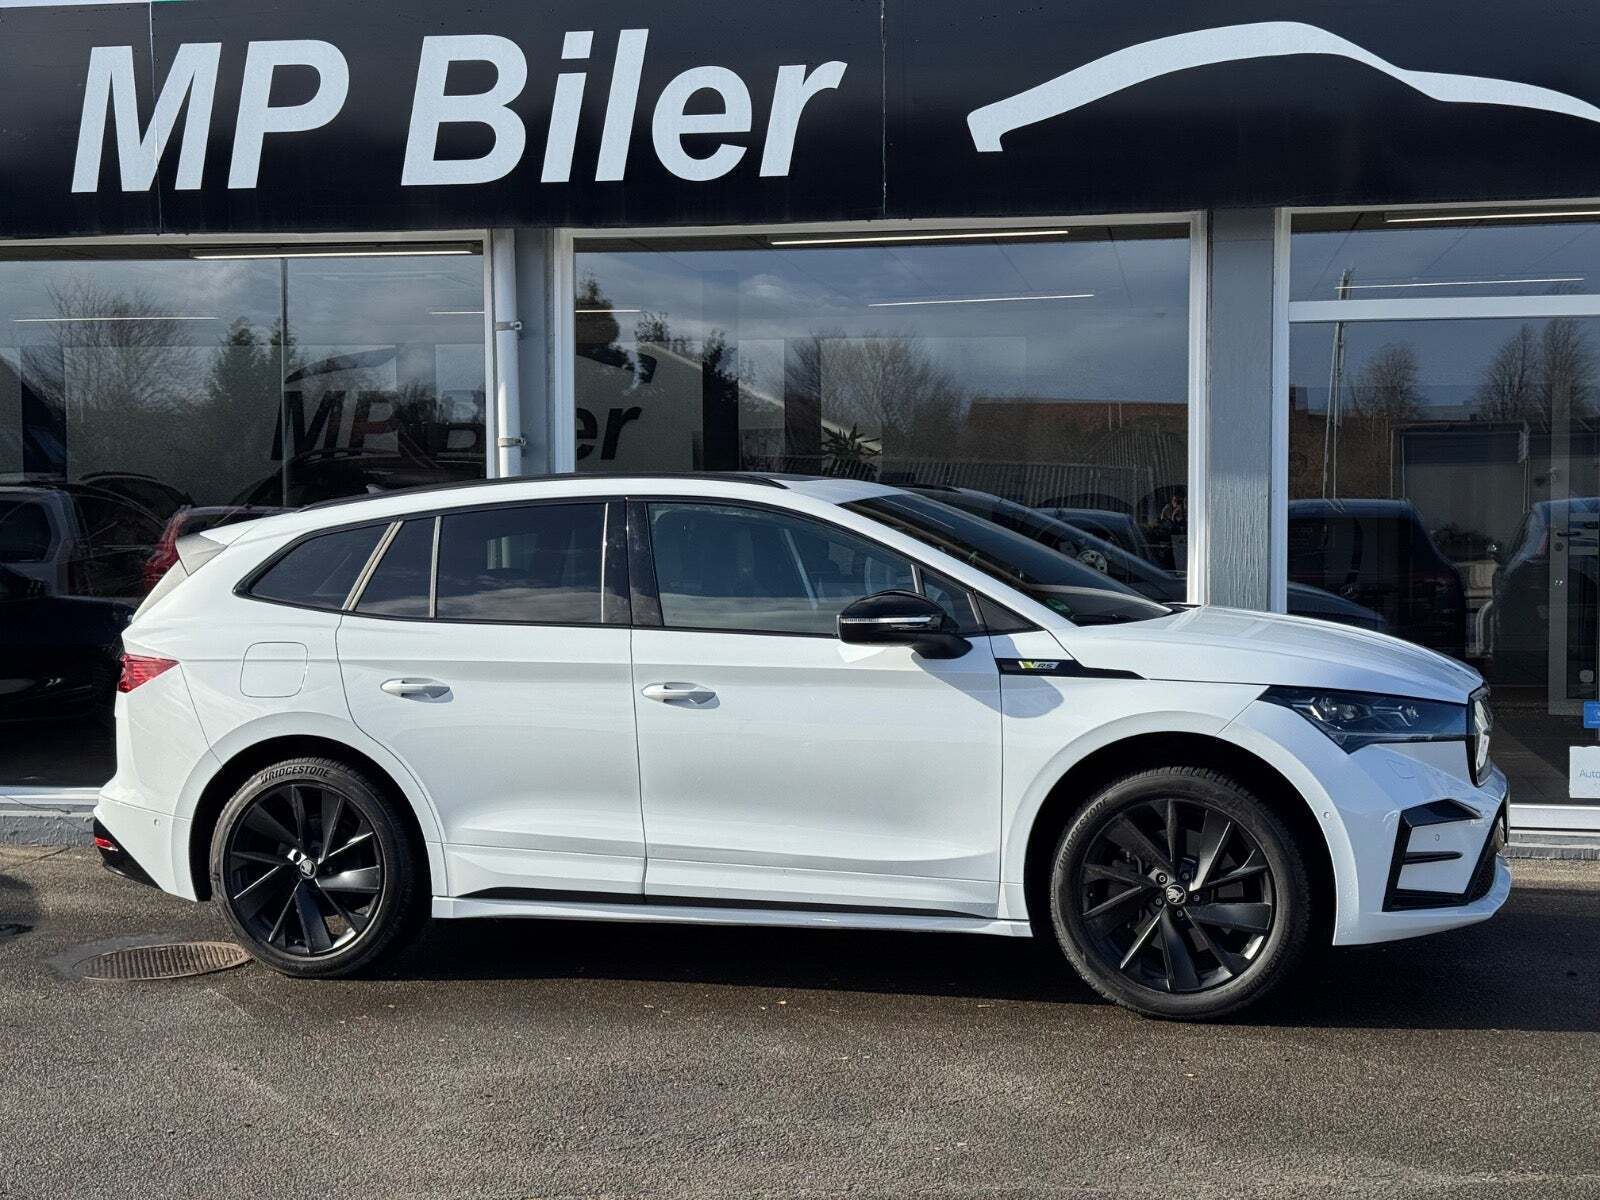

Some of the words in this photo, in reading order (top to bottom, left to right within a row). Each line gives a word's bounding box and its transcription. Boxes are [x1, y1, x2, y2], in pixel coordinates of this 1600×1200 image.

[71, 40, 349, 192] MP
[401, 29, 847, 186] Biler
[260, 766, 330, 785] BRIDGESTONE
